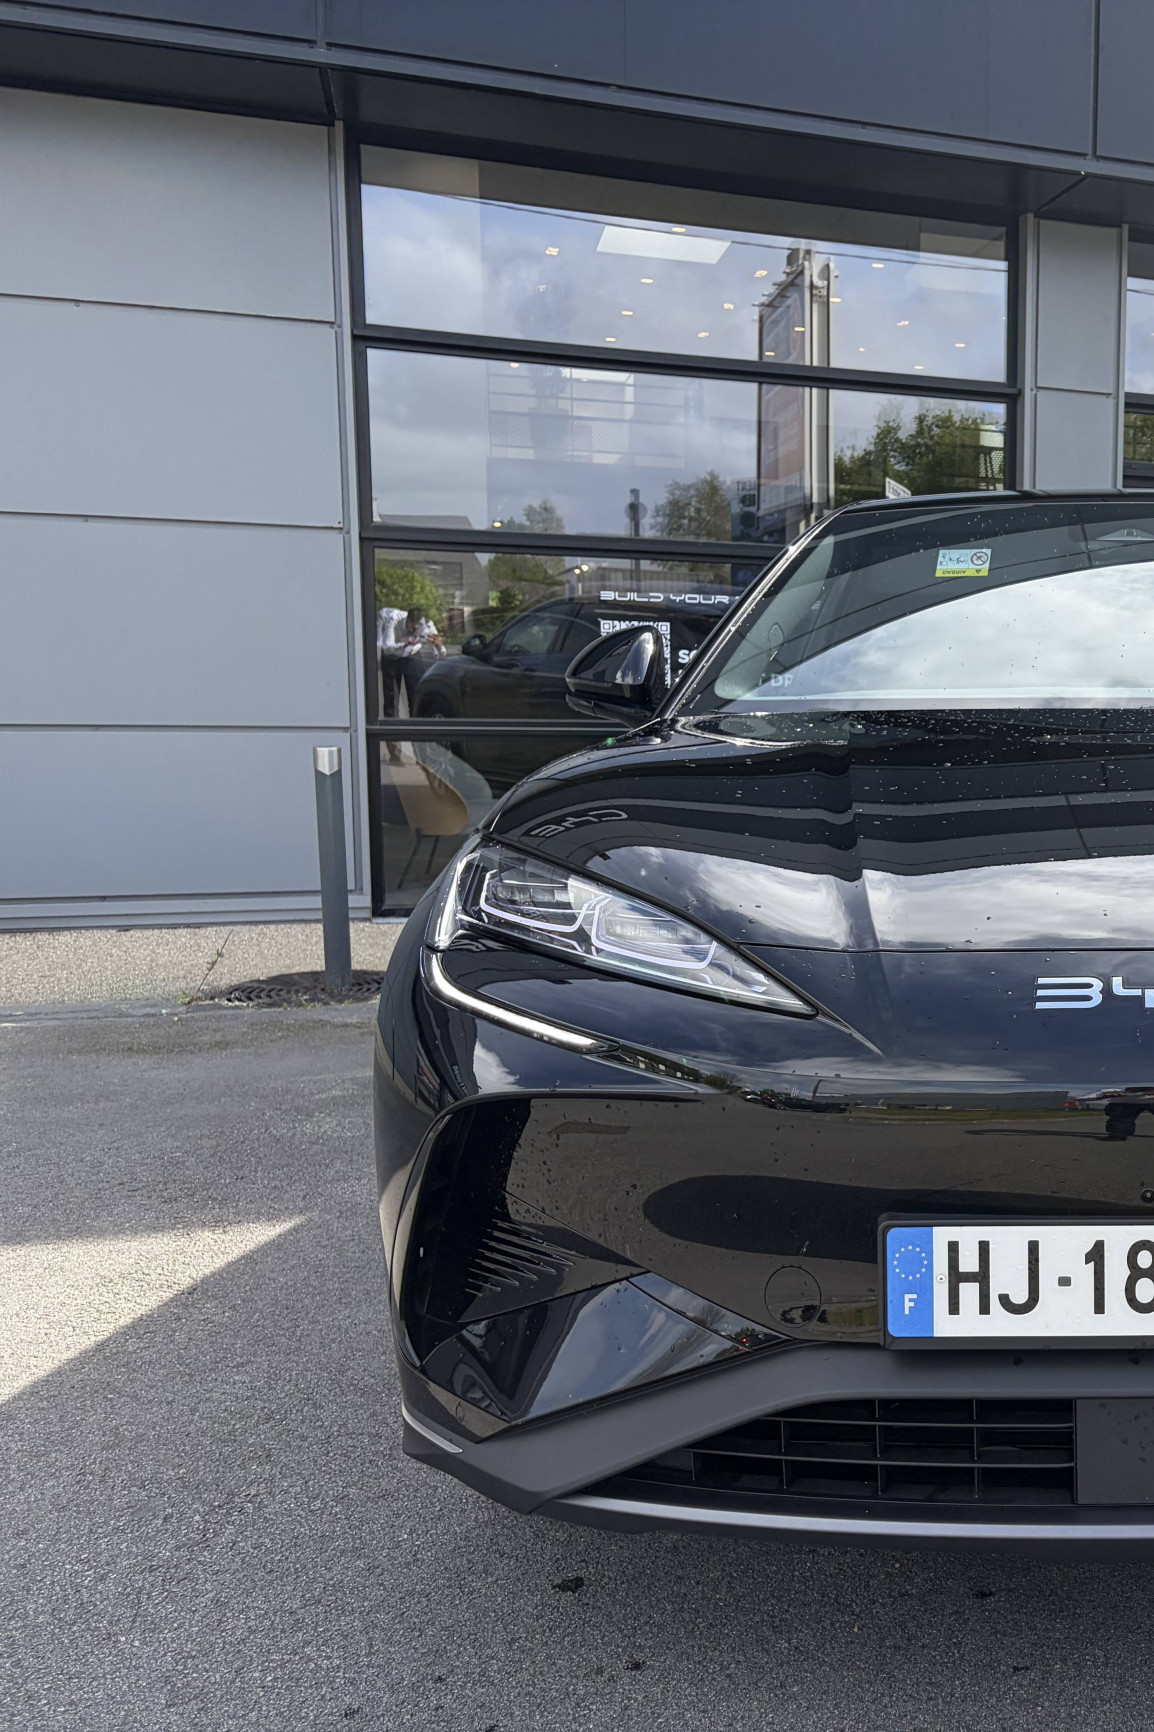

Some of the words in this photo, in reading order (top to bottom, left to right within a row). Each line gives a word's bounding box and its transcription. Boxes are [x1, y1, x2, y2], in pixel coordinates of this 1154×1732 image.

[600, 591, 664, 602] BUILD
[669, 593, 729, 604] YOUR
[904, 1293, 917, 1314] F
